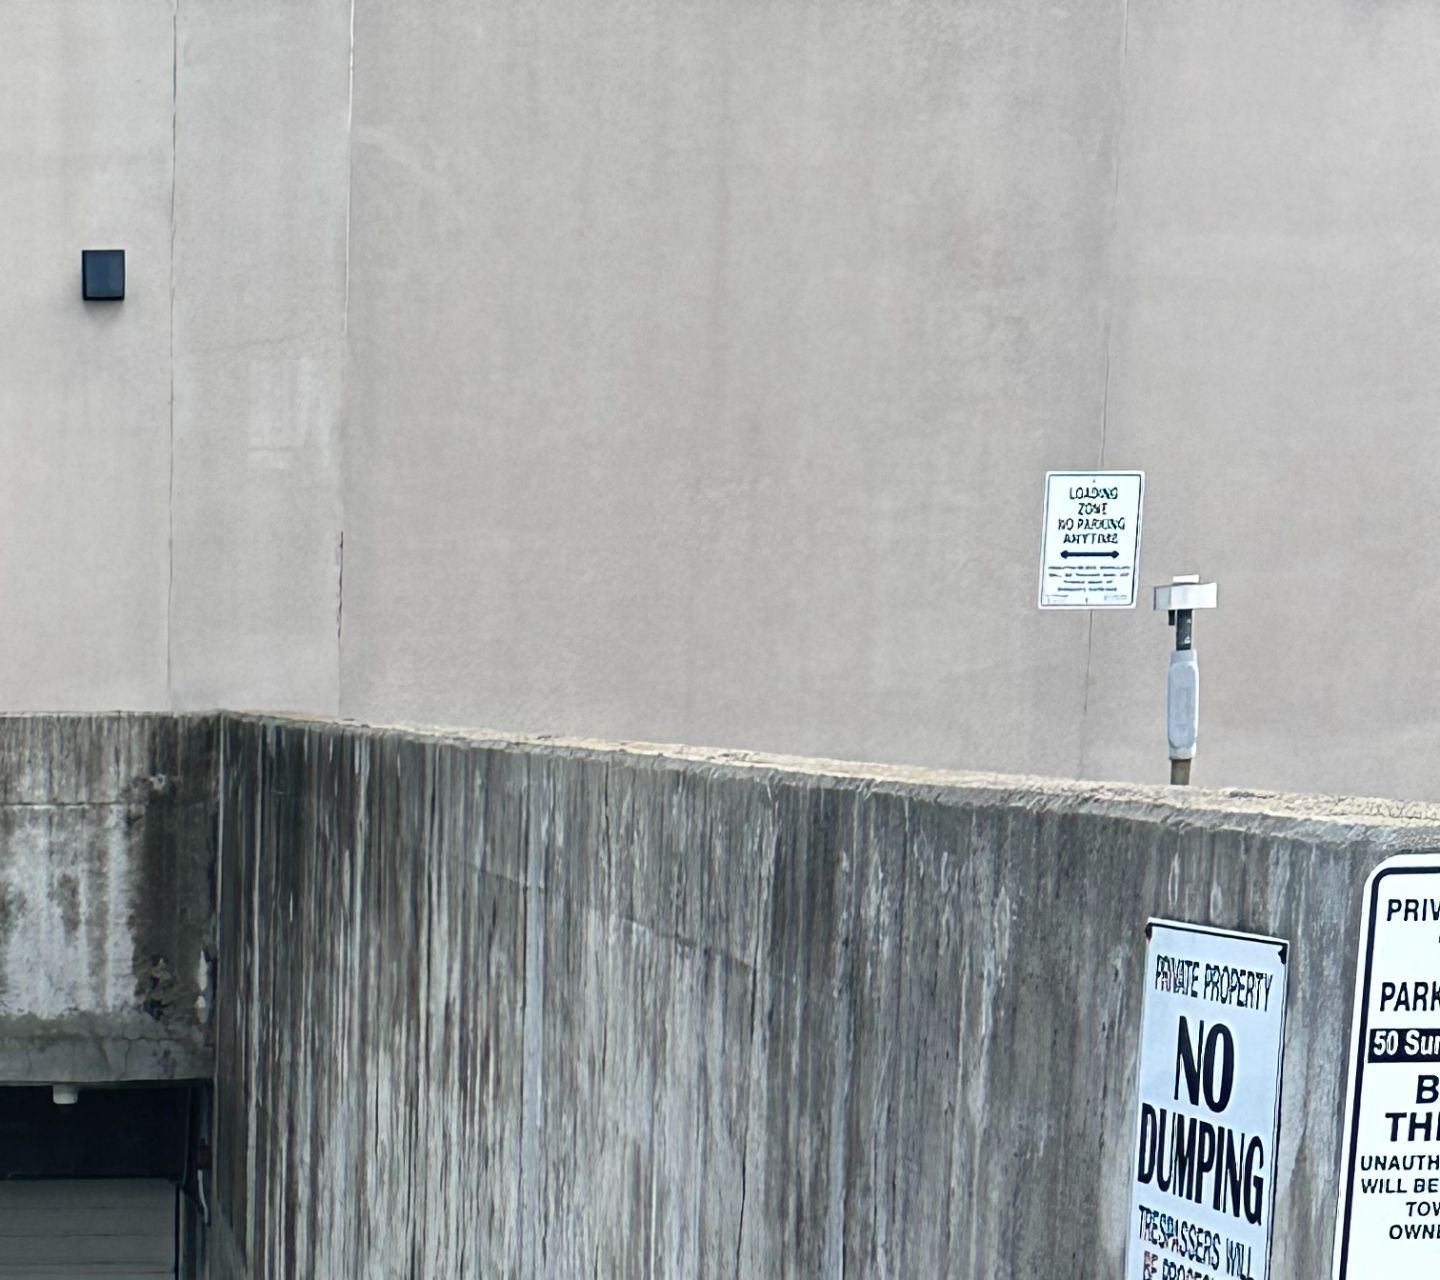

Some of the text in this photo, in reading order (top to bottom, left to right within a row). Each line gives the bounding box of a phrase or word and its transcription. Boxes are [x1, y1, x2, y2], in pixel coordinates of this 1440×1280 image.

[1069, 486, 1118, 500] LOADING
[1058, 516, 1125, 530] NO PARKING
[1155, 954, 1273, 1012] PRIVATE PROPERTY
[1373, 1030, 1399, 1056] 50
[1174, 1015, 1235, 1114] NO
[1137, 1102, 1264, 1226] DUMPING
[1361, 1178, 1439, 1194] WILL BE
[1139, 1204, 1221, 1271] TRESPASSERS
